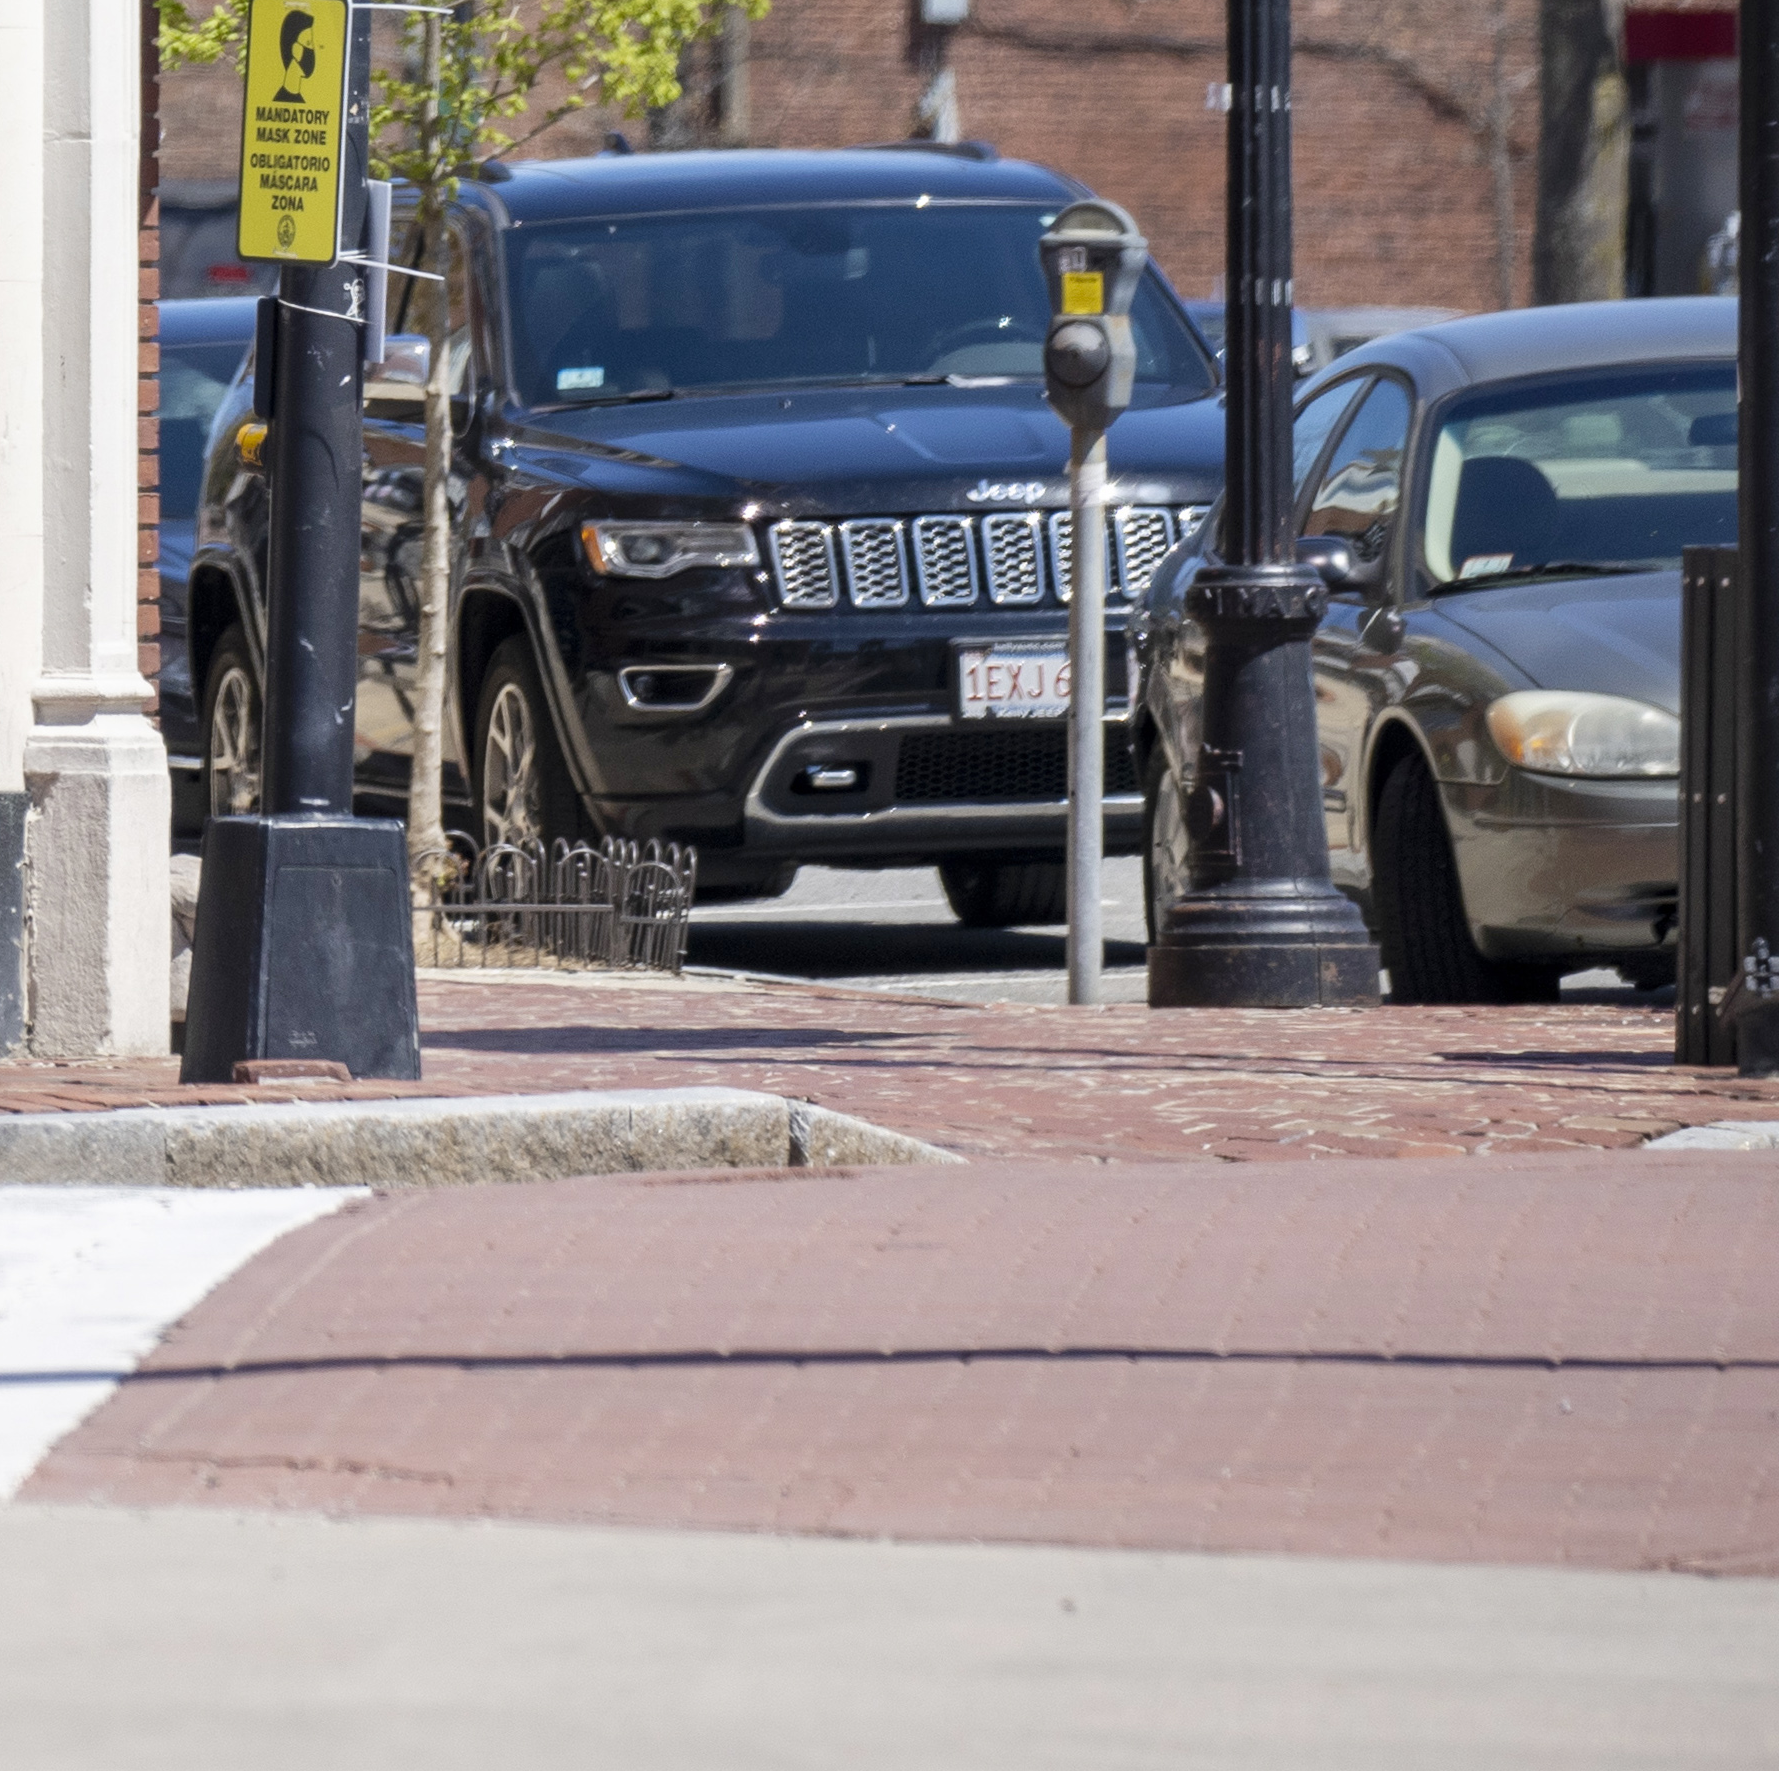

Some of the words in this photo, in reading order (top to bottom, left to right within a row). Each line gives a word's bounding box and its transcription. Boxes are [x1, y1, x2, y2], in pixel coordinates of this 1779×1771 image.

[255, 105, 330, 126] MANDATORY
[256, 126, 291, 144] MASK
[293, 128, 327, 146] ZONE
[250, 152, 331, 172] OBLIGATORIO
[259, 170, 319, 192] MÁSCARA
[271, 194, 305, 212] ZONA
[966, 478, 1047, 505] Jeep
[966, 662, 1045, 702] 1EXJ
[1053, 659, 1072, 698] 6
